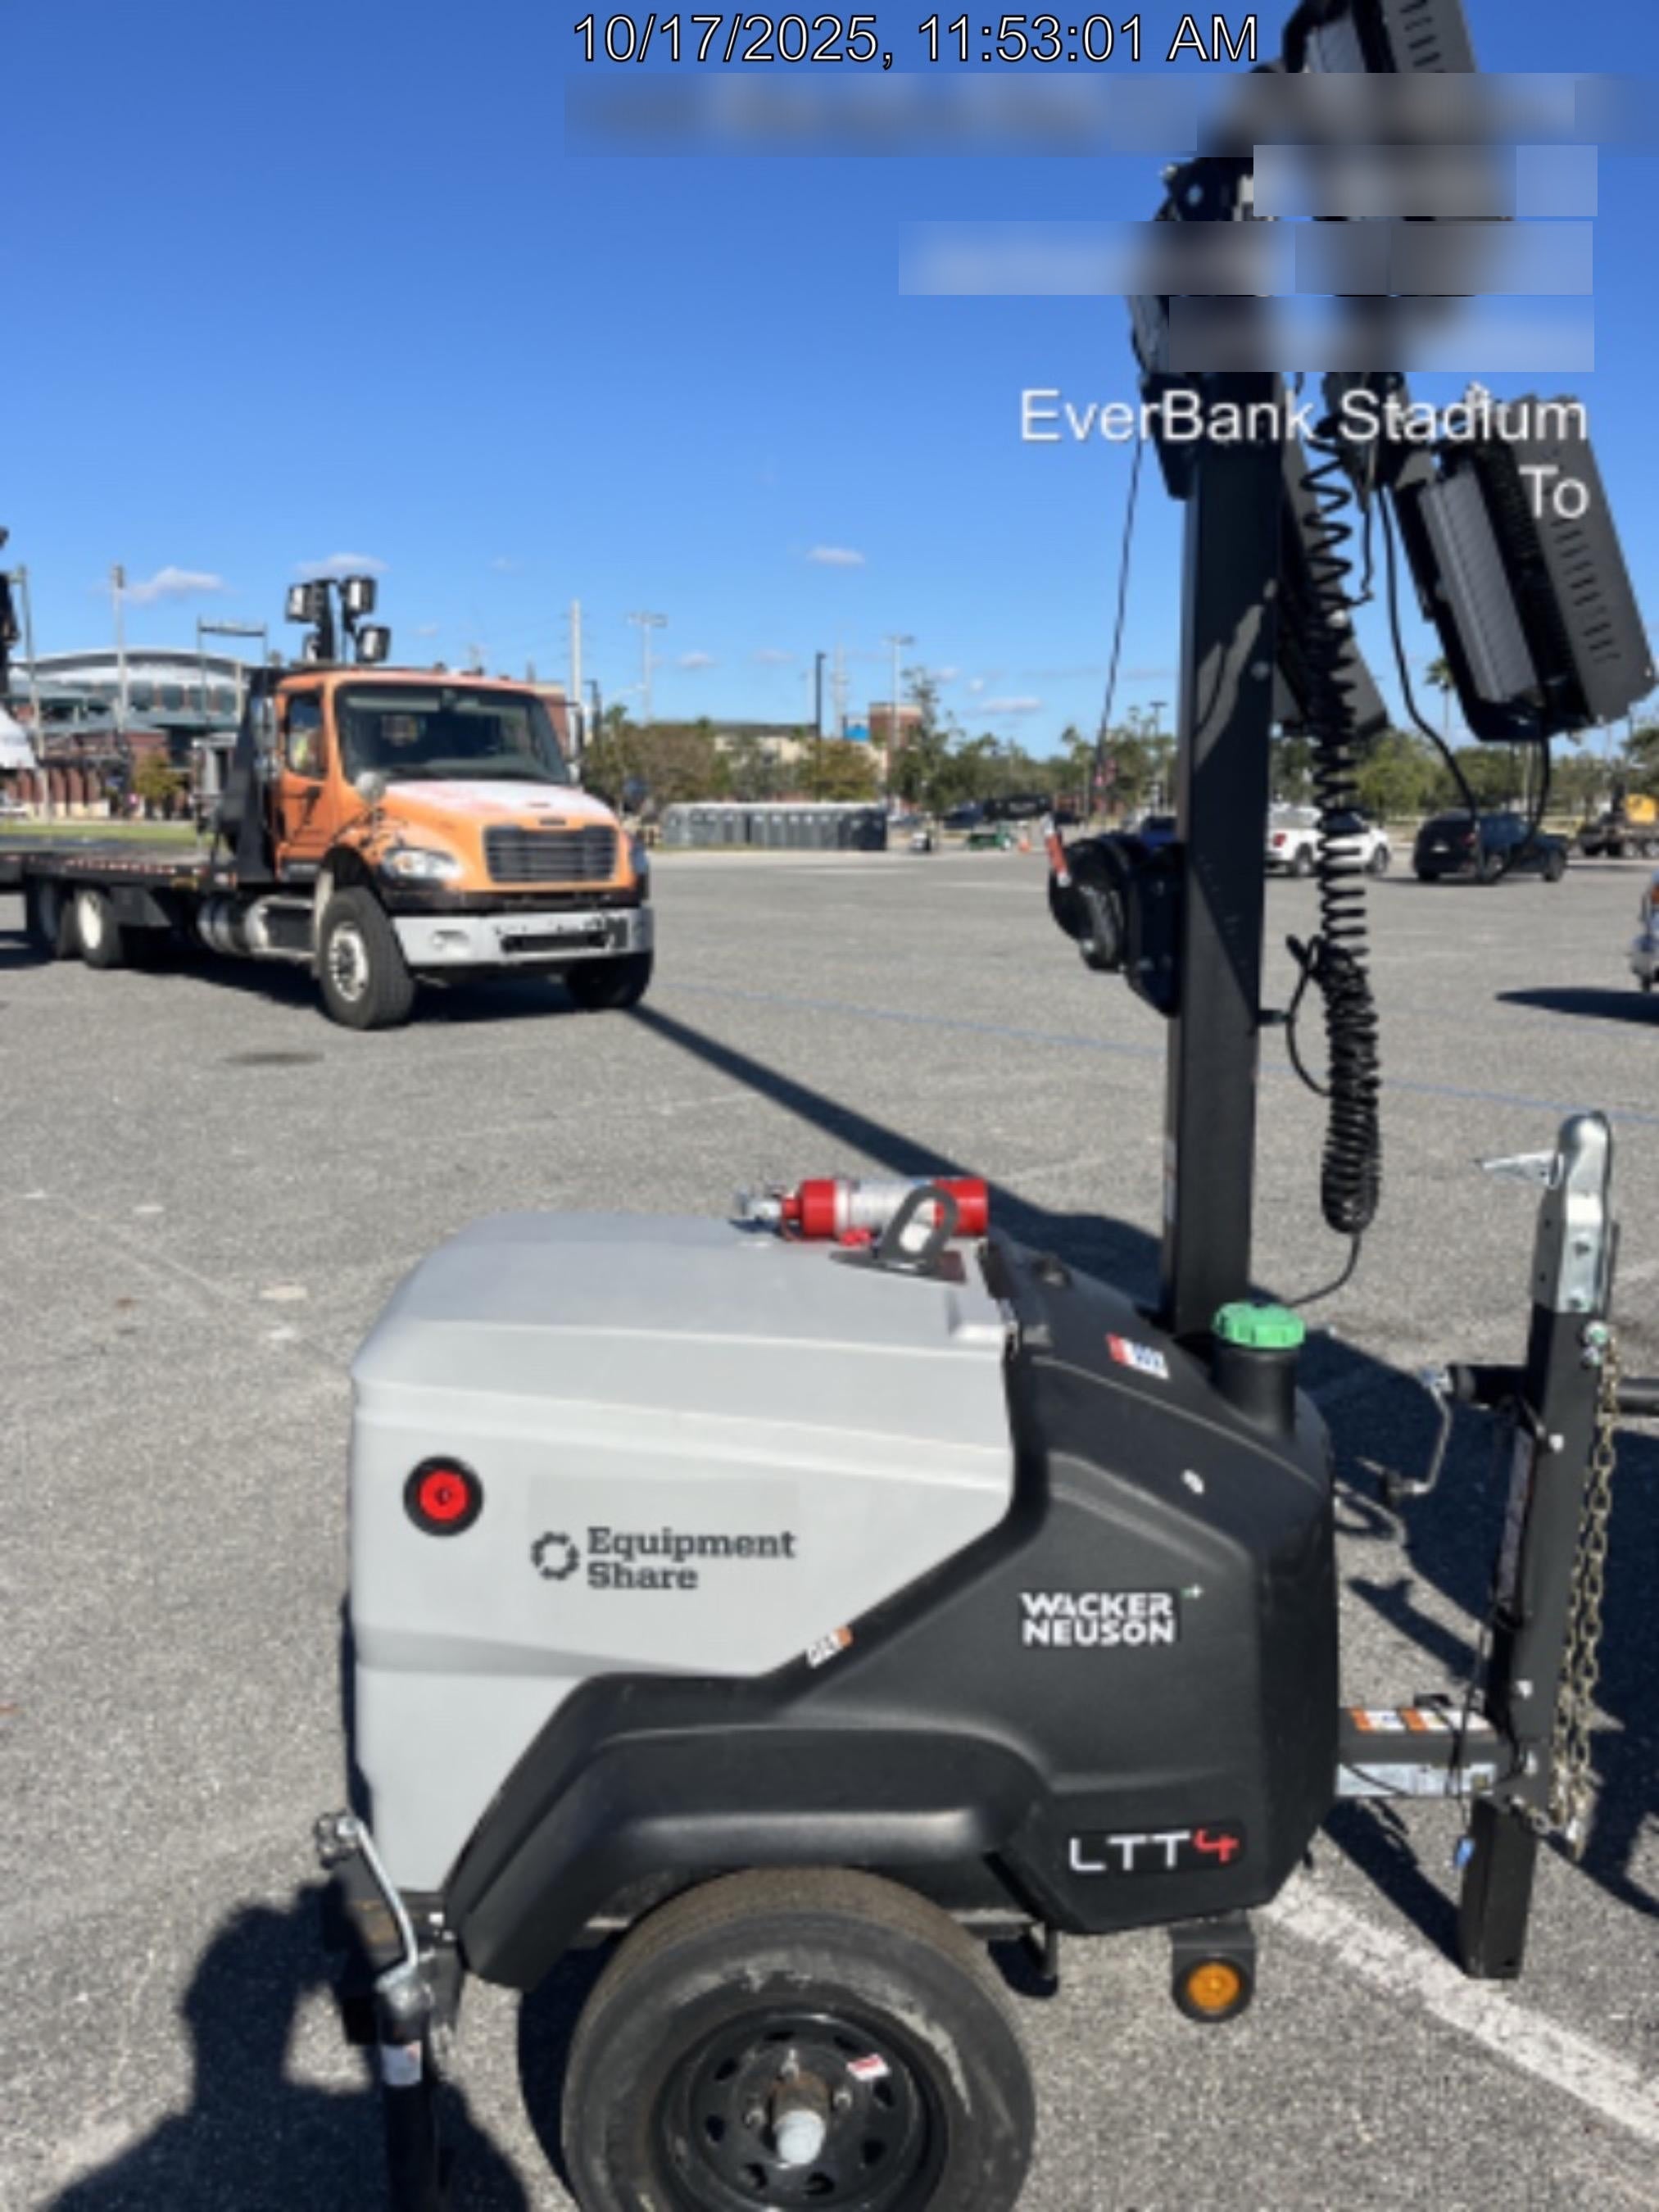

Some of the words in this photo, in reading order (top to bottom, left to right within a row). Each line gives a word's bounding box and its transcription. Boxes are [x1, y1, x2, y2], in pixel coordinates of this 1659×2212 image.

[587, 1525, 796, 1562] Equipment
[587, 1561, 699, 1590] Share
[1021, 1592, 1174, 1617] WACKER
[1022, 1619, 1176, 1647] NEUSON
[1069, 1828, 1240, 1872] LTT4
